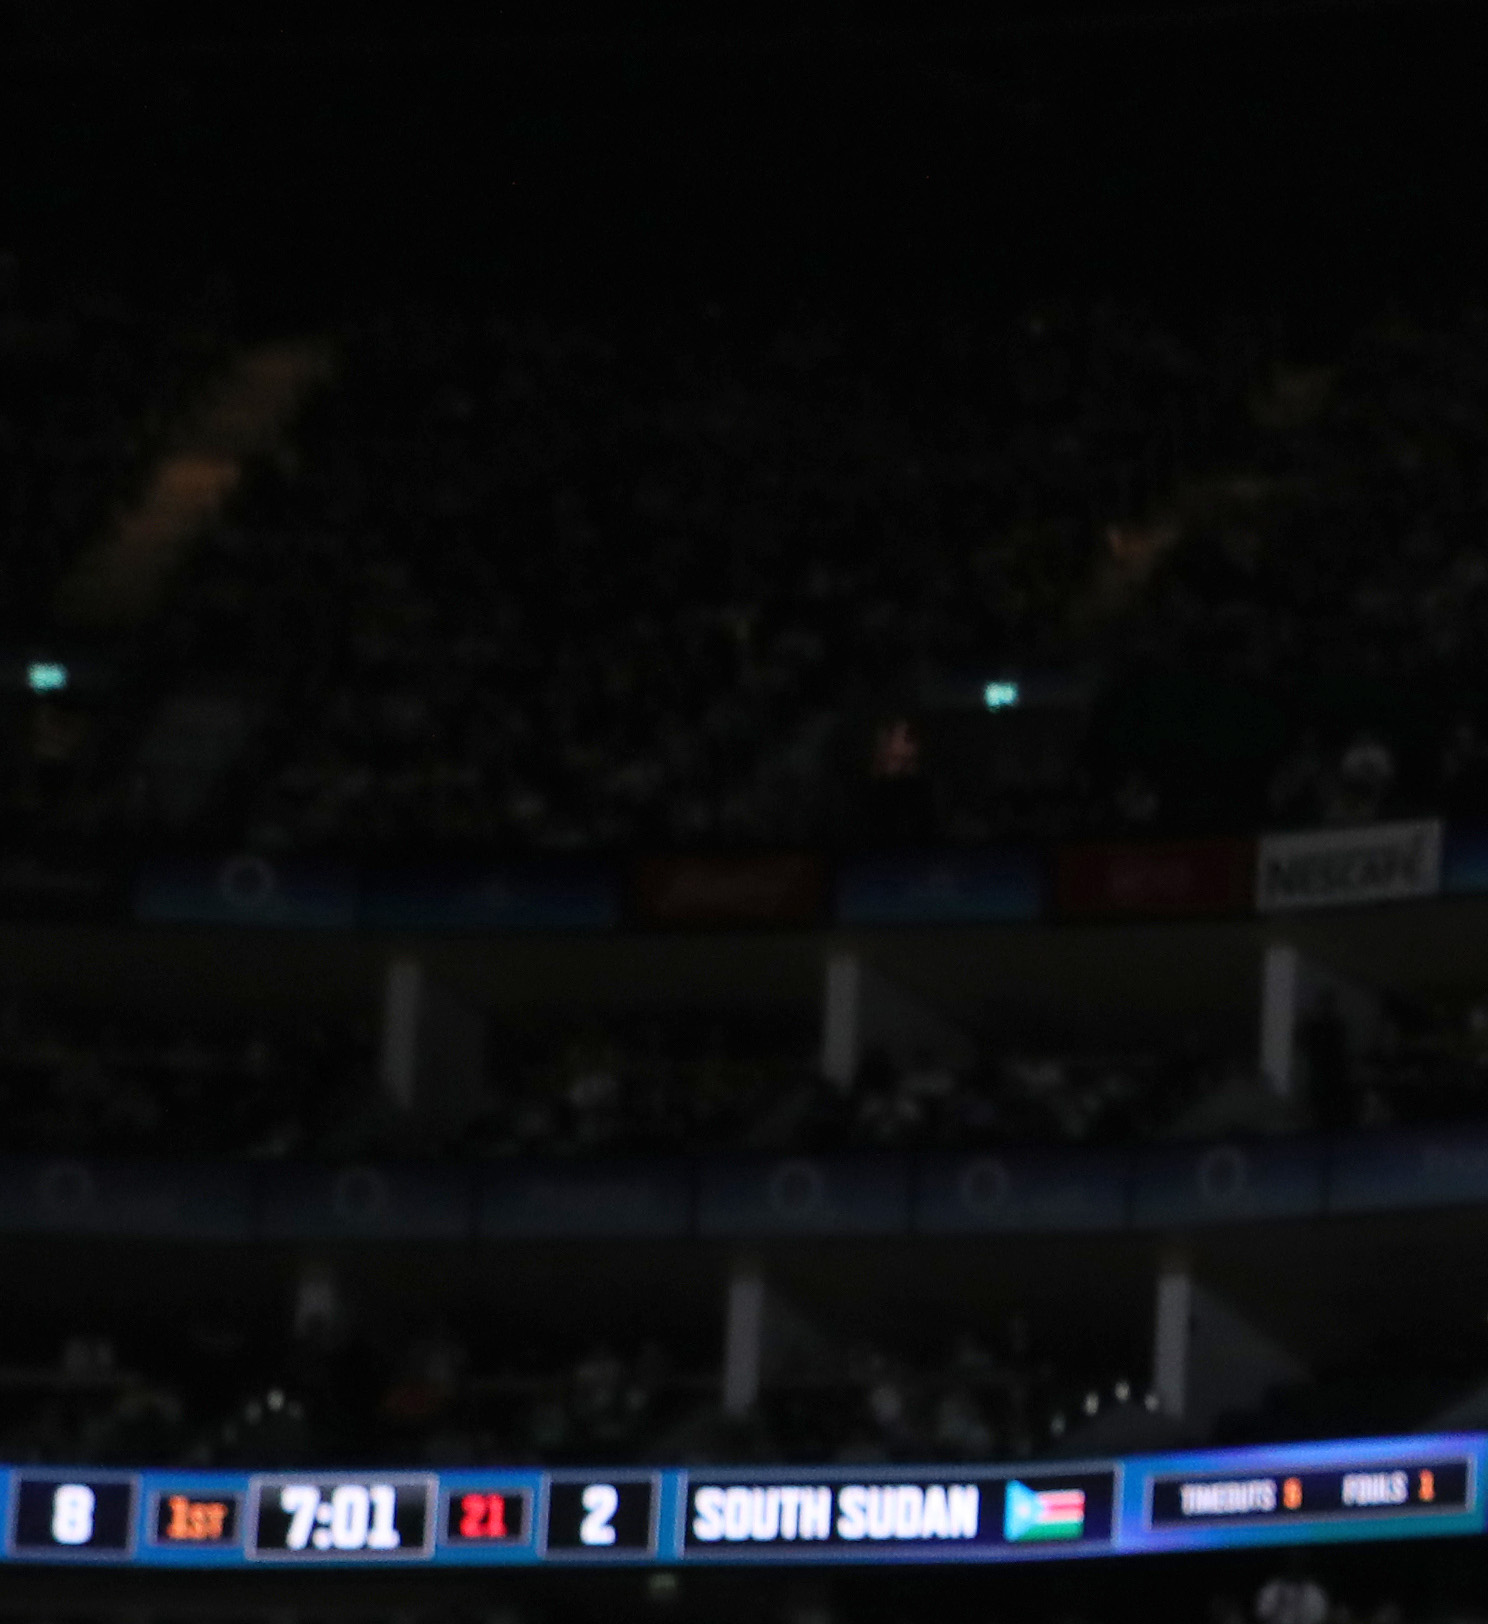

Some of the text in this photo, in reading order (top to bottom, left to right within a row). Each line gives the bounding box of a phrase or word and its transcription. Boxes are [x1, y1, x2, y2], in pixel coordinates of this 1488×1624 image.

[52, 1484, 95, 1545] 8
[280, 1484, 400, 1550] 7:01
[460, 1493, 508, 1539] 21
[580, 1484, 619, 1546] 2
[692, 1484, 979, 1541] SOUTH SUDAN
